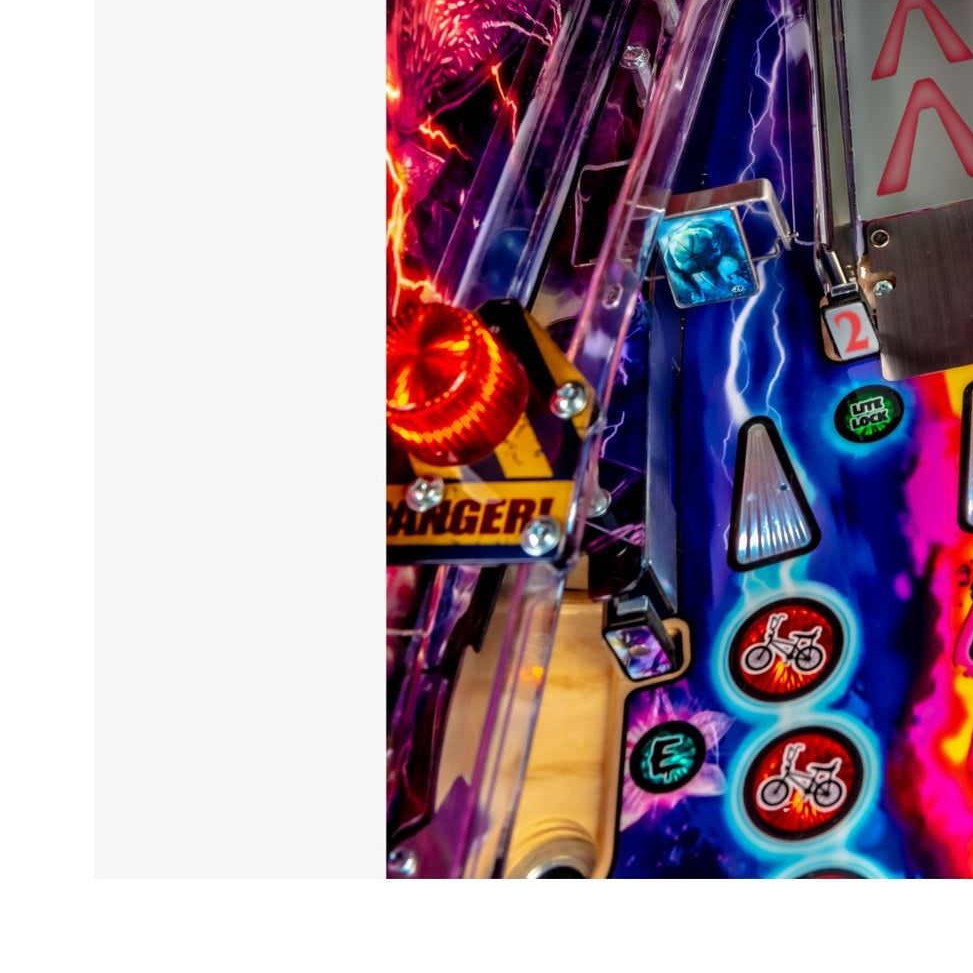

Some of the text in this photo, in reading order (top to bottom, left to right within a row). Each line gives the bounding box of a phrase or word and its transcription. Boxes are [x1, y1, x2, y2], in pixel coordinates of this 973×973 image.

[832, 310, 870, 353] 2
[850, 409, 890, 431] LOCK
[851, 396, 884, 416] LITE
[647, 733, 685, 783] E
